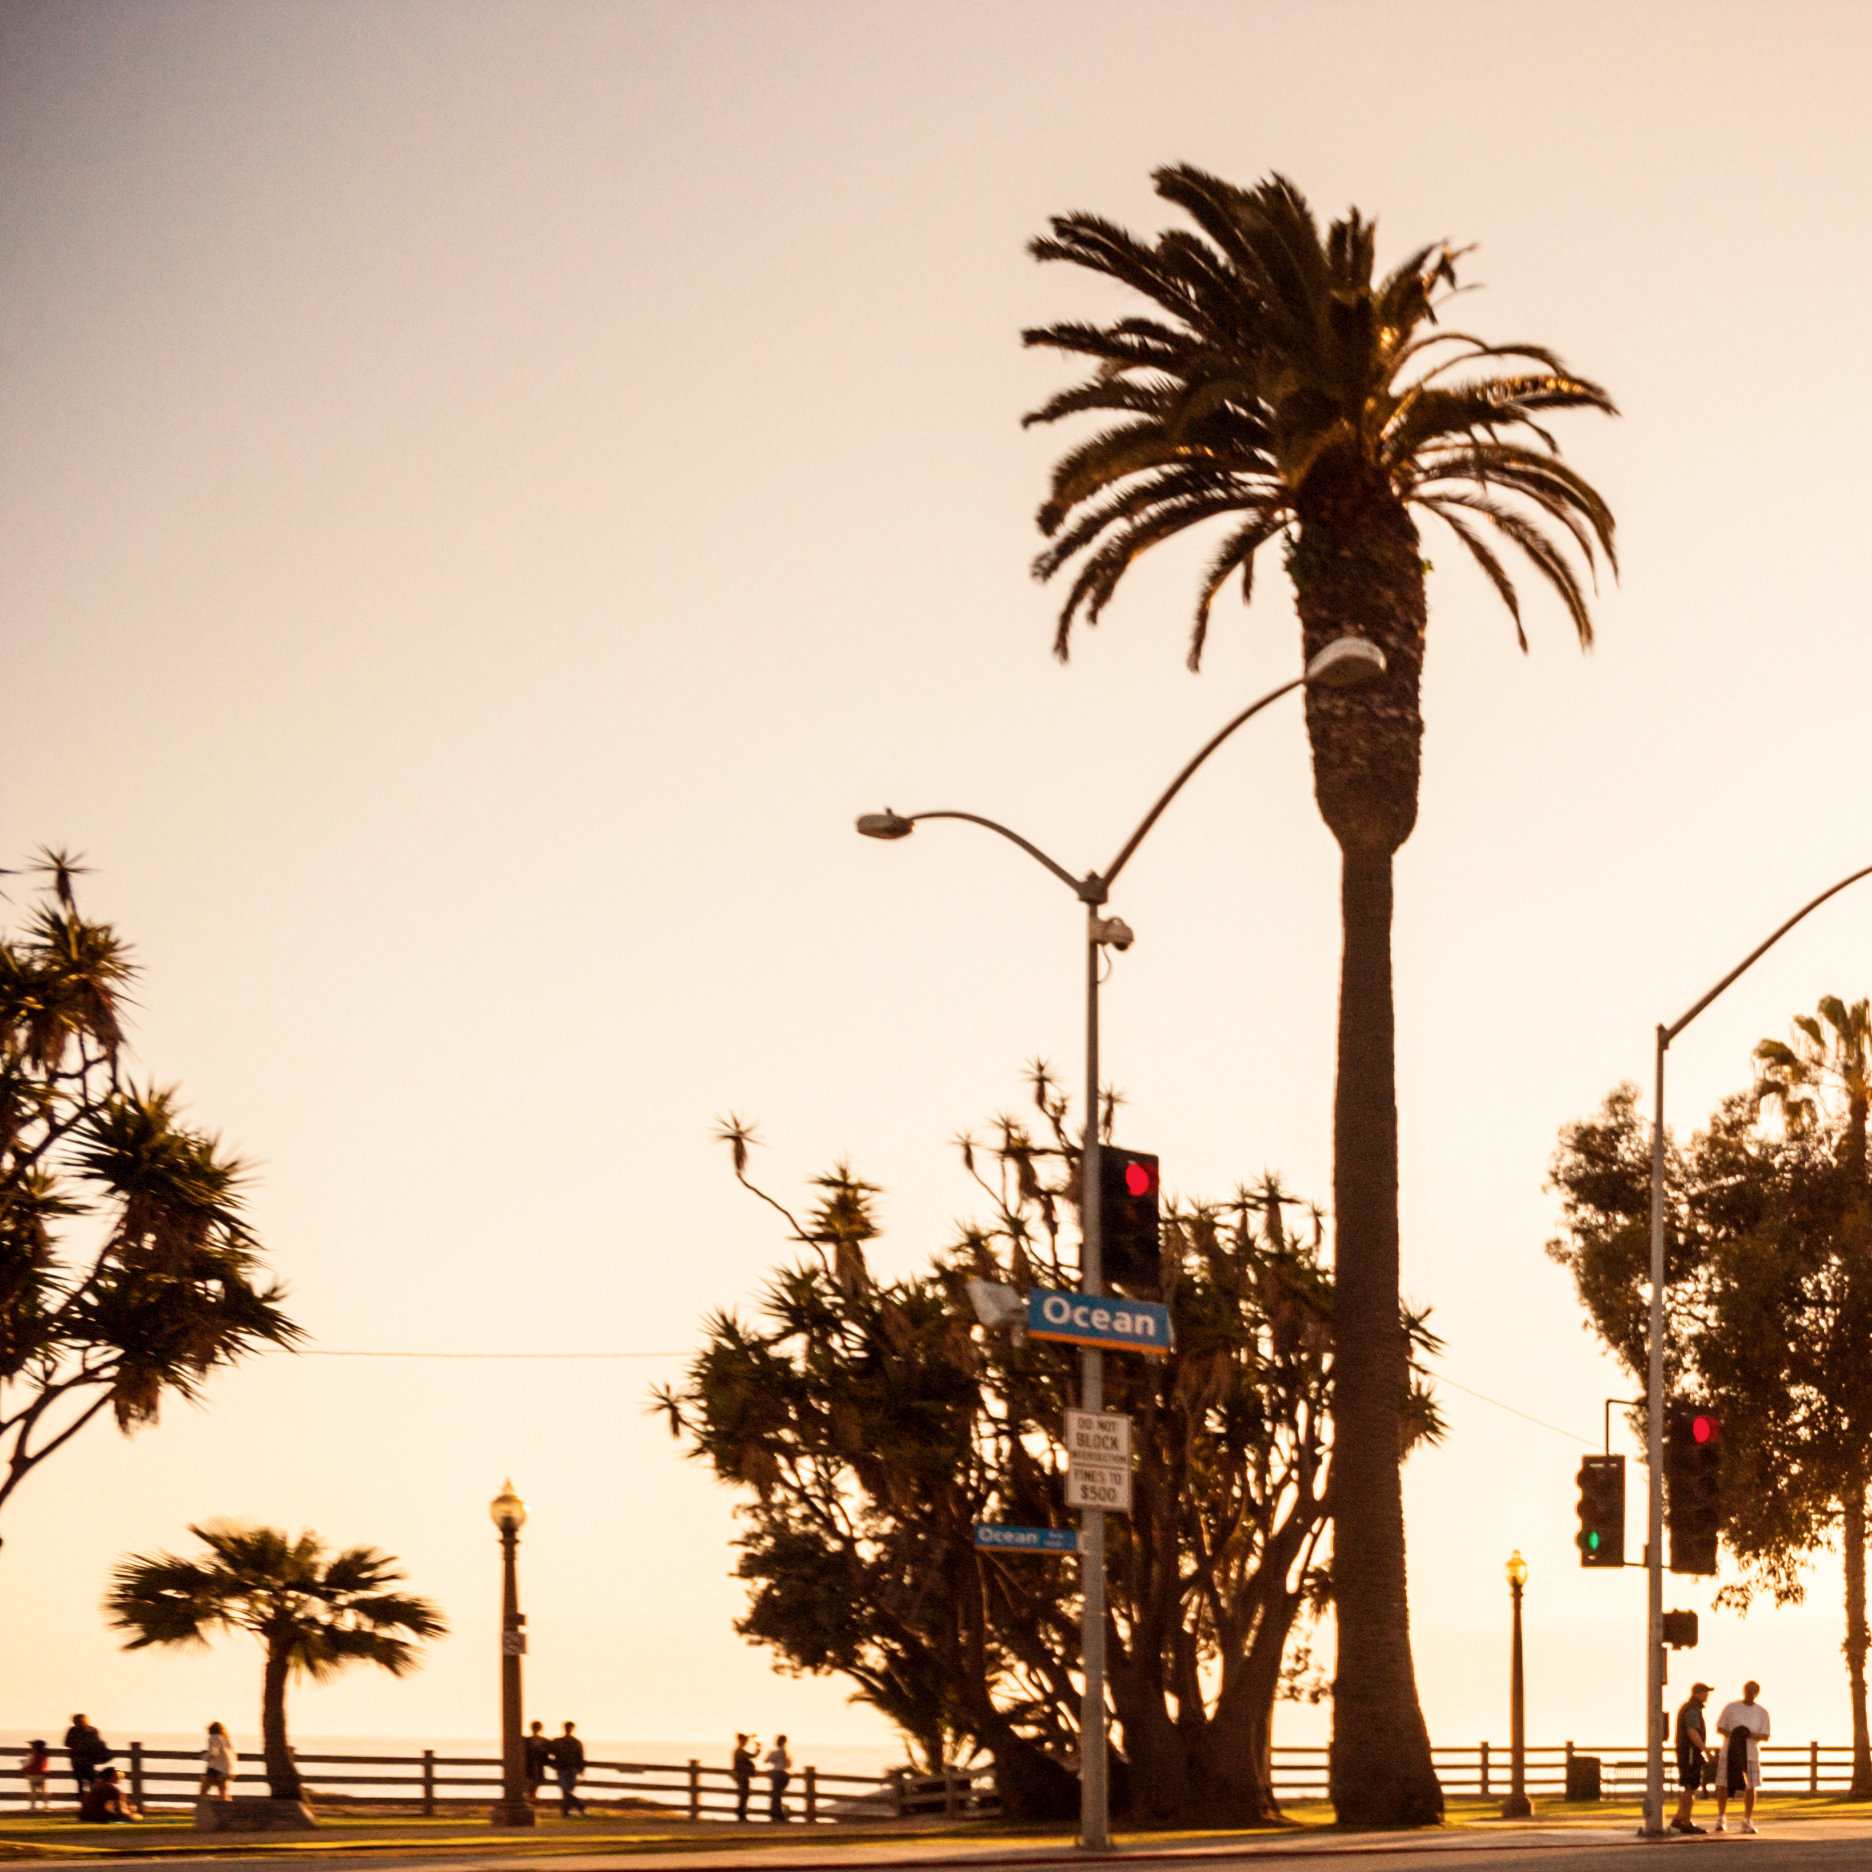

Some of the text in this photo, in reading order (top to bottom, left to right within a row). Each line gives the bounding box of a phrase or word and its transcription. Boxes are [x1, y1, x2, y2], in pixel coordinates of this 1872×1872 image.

[1042, 1295, 1156, 1337] Ocean
[1097, 1420, 1117, 1433] NOT
[1076, 1432, 1119, 1450] BLOCK
[1110, 1471, 1122, 1485] TO
[1080, 1484, 1118, 1502] $500
[978, 1527, 1039, 1545] Ocean
